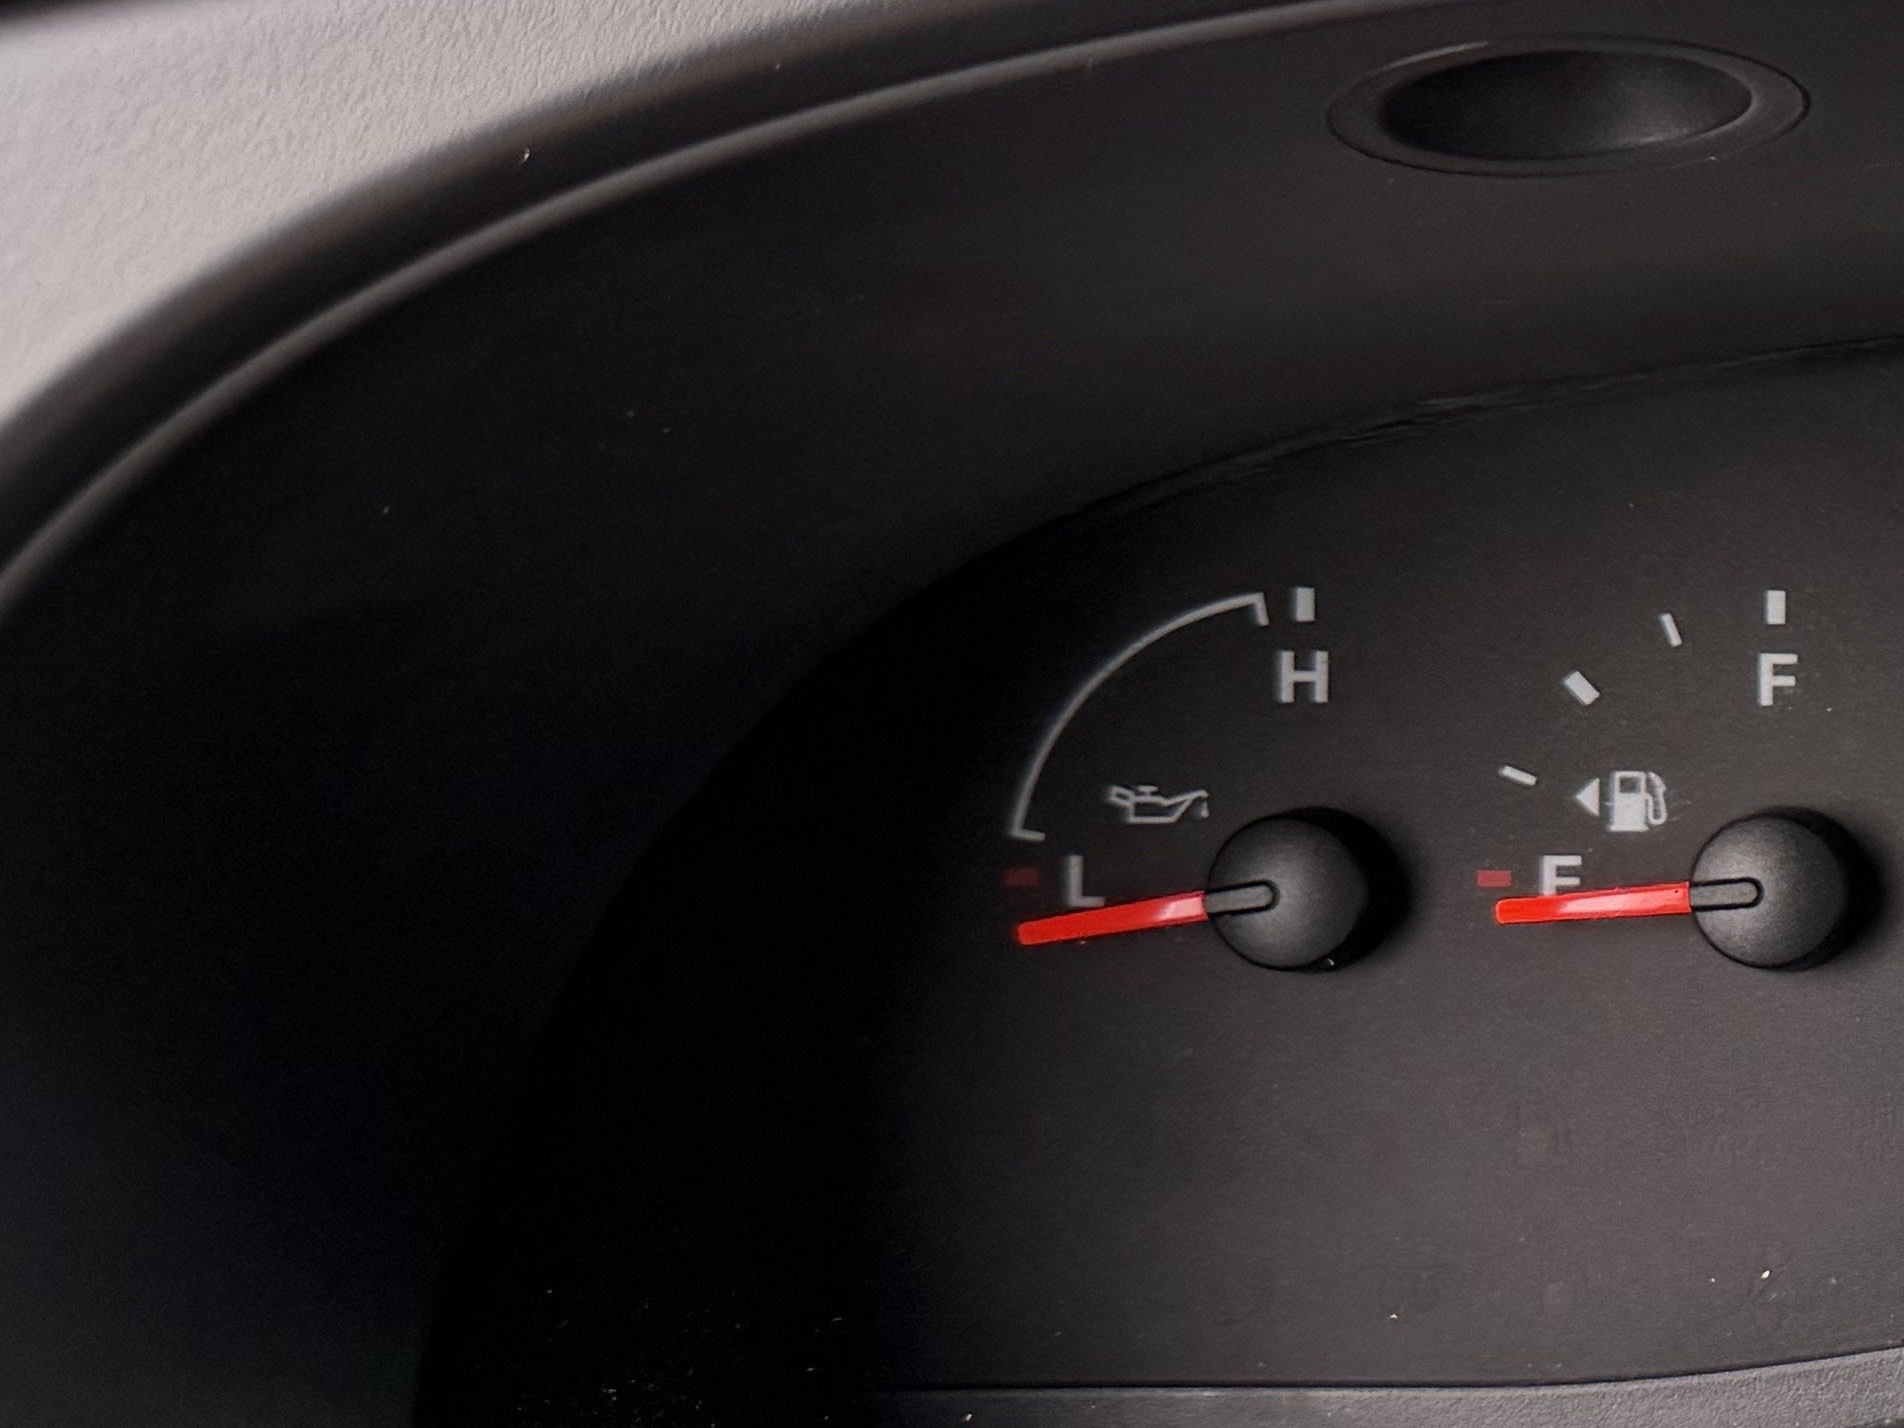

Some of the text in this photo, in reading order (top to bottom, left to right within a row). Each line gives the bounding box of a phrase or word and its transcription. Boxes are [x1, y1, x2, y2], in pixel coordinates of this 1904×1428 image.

[1279, 650, 1329, 703] H
[1758, 653, 1798, 707] F
[1067, 855, 1105, 908] L
